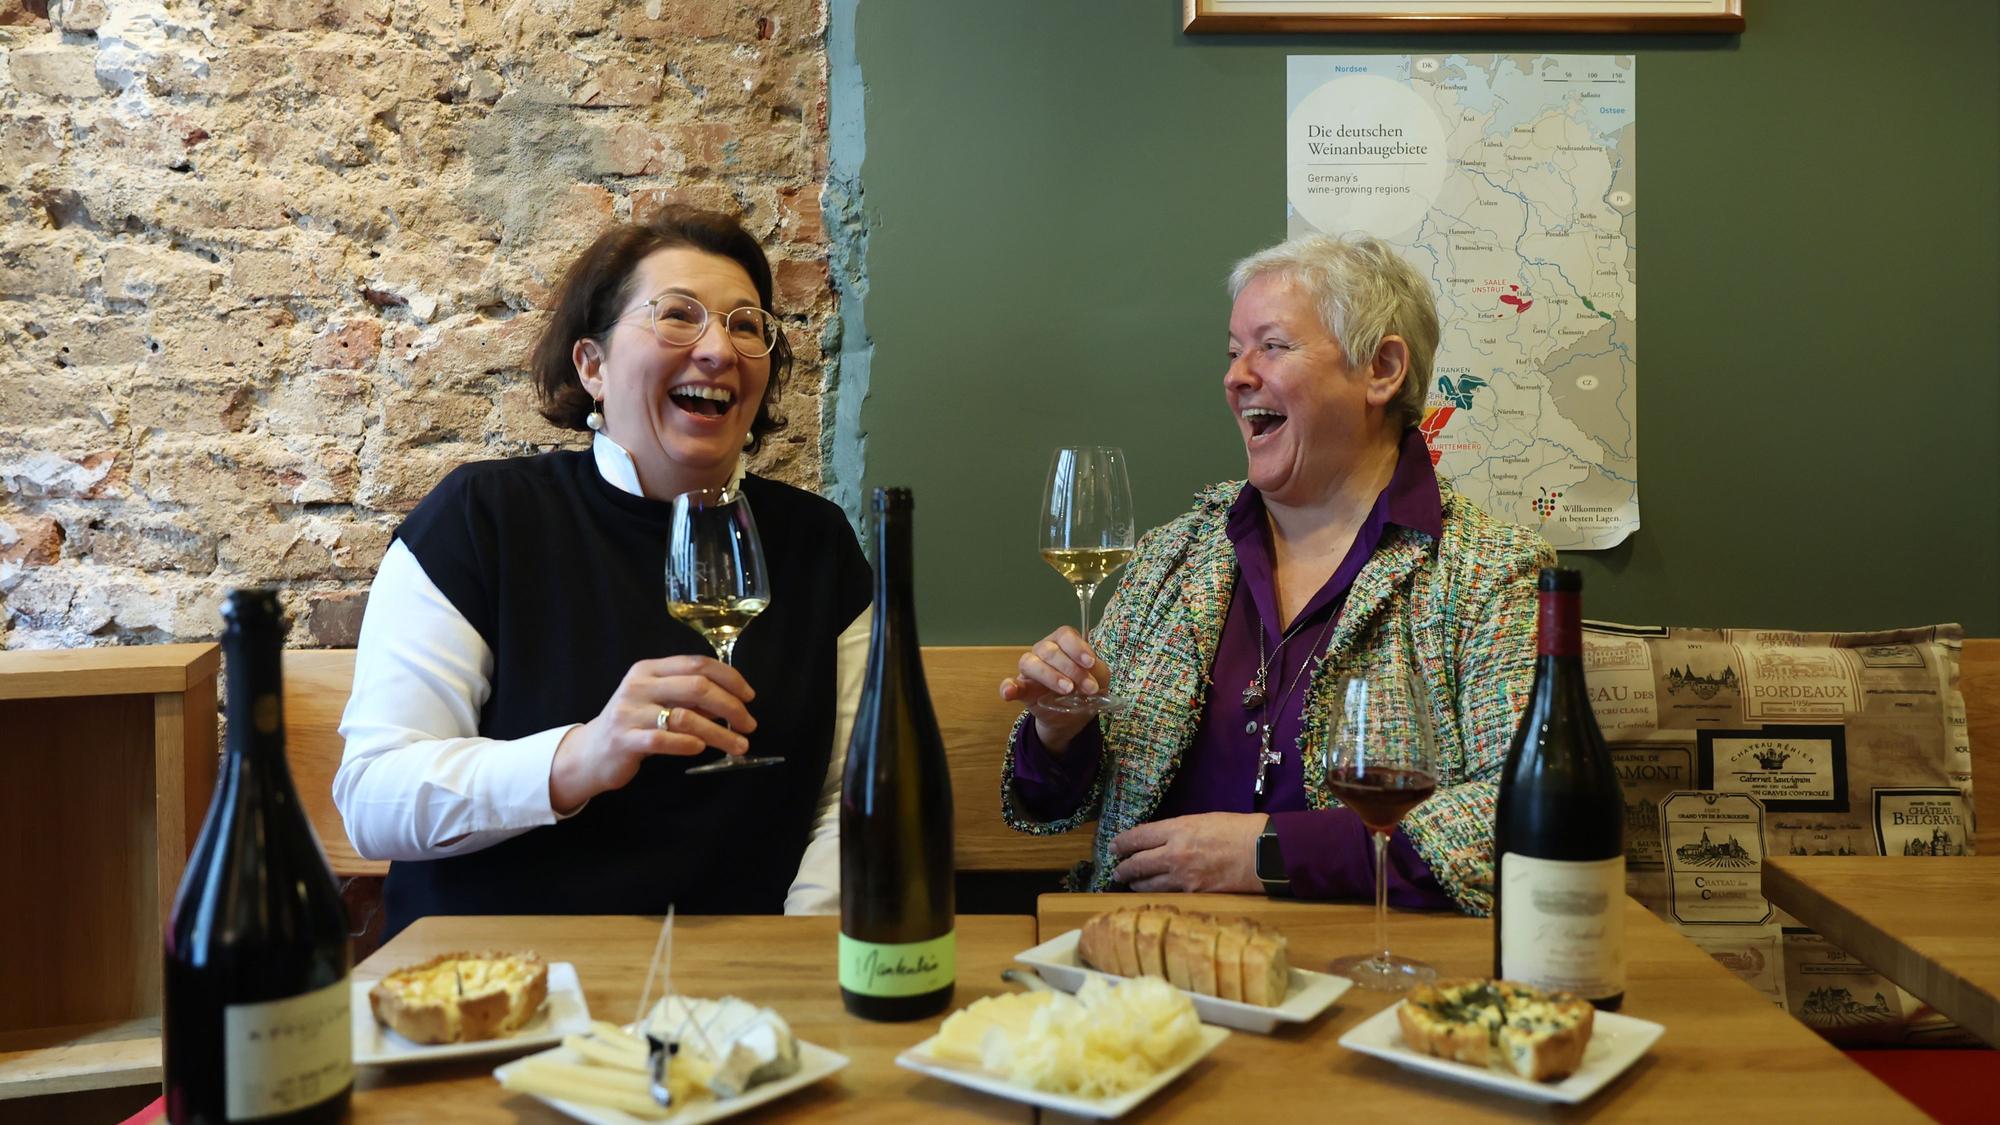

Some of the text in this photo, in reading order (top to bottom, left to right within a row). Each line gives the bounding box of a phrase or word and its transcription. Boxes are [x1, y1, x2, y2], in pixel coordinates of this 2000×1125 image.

[1600, 106, 1626, 114] Ostsee
[1308, 123, 1404, 138] Die deutschen
[1308, 141, 1428, 159] Weinanbaugebiete
[1460, 159, 1487, 167] Hamburg
[1308, 173, 1358, 184] Germany's
[1308, 184, 1411, 196] wine-growing regions
[1589, 291, 1621, 299] SACHSEN
[1562, 504, 1613, 512] Willkommen
[1569, 514, 1594, 522] besten
[1753, 685, 1849, 698] BORDEAUX
[1739, 773, 1811, 785] Cabernet Sauvignon
[1892, 811, 1962, 825] BELGRAVE
